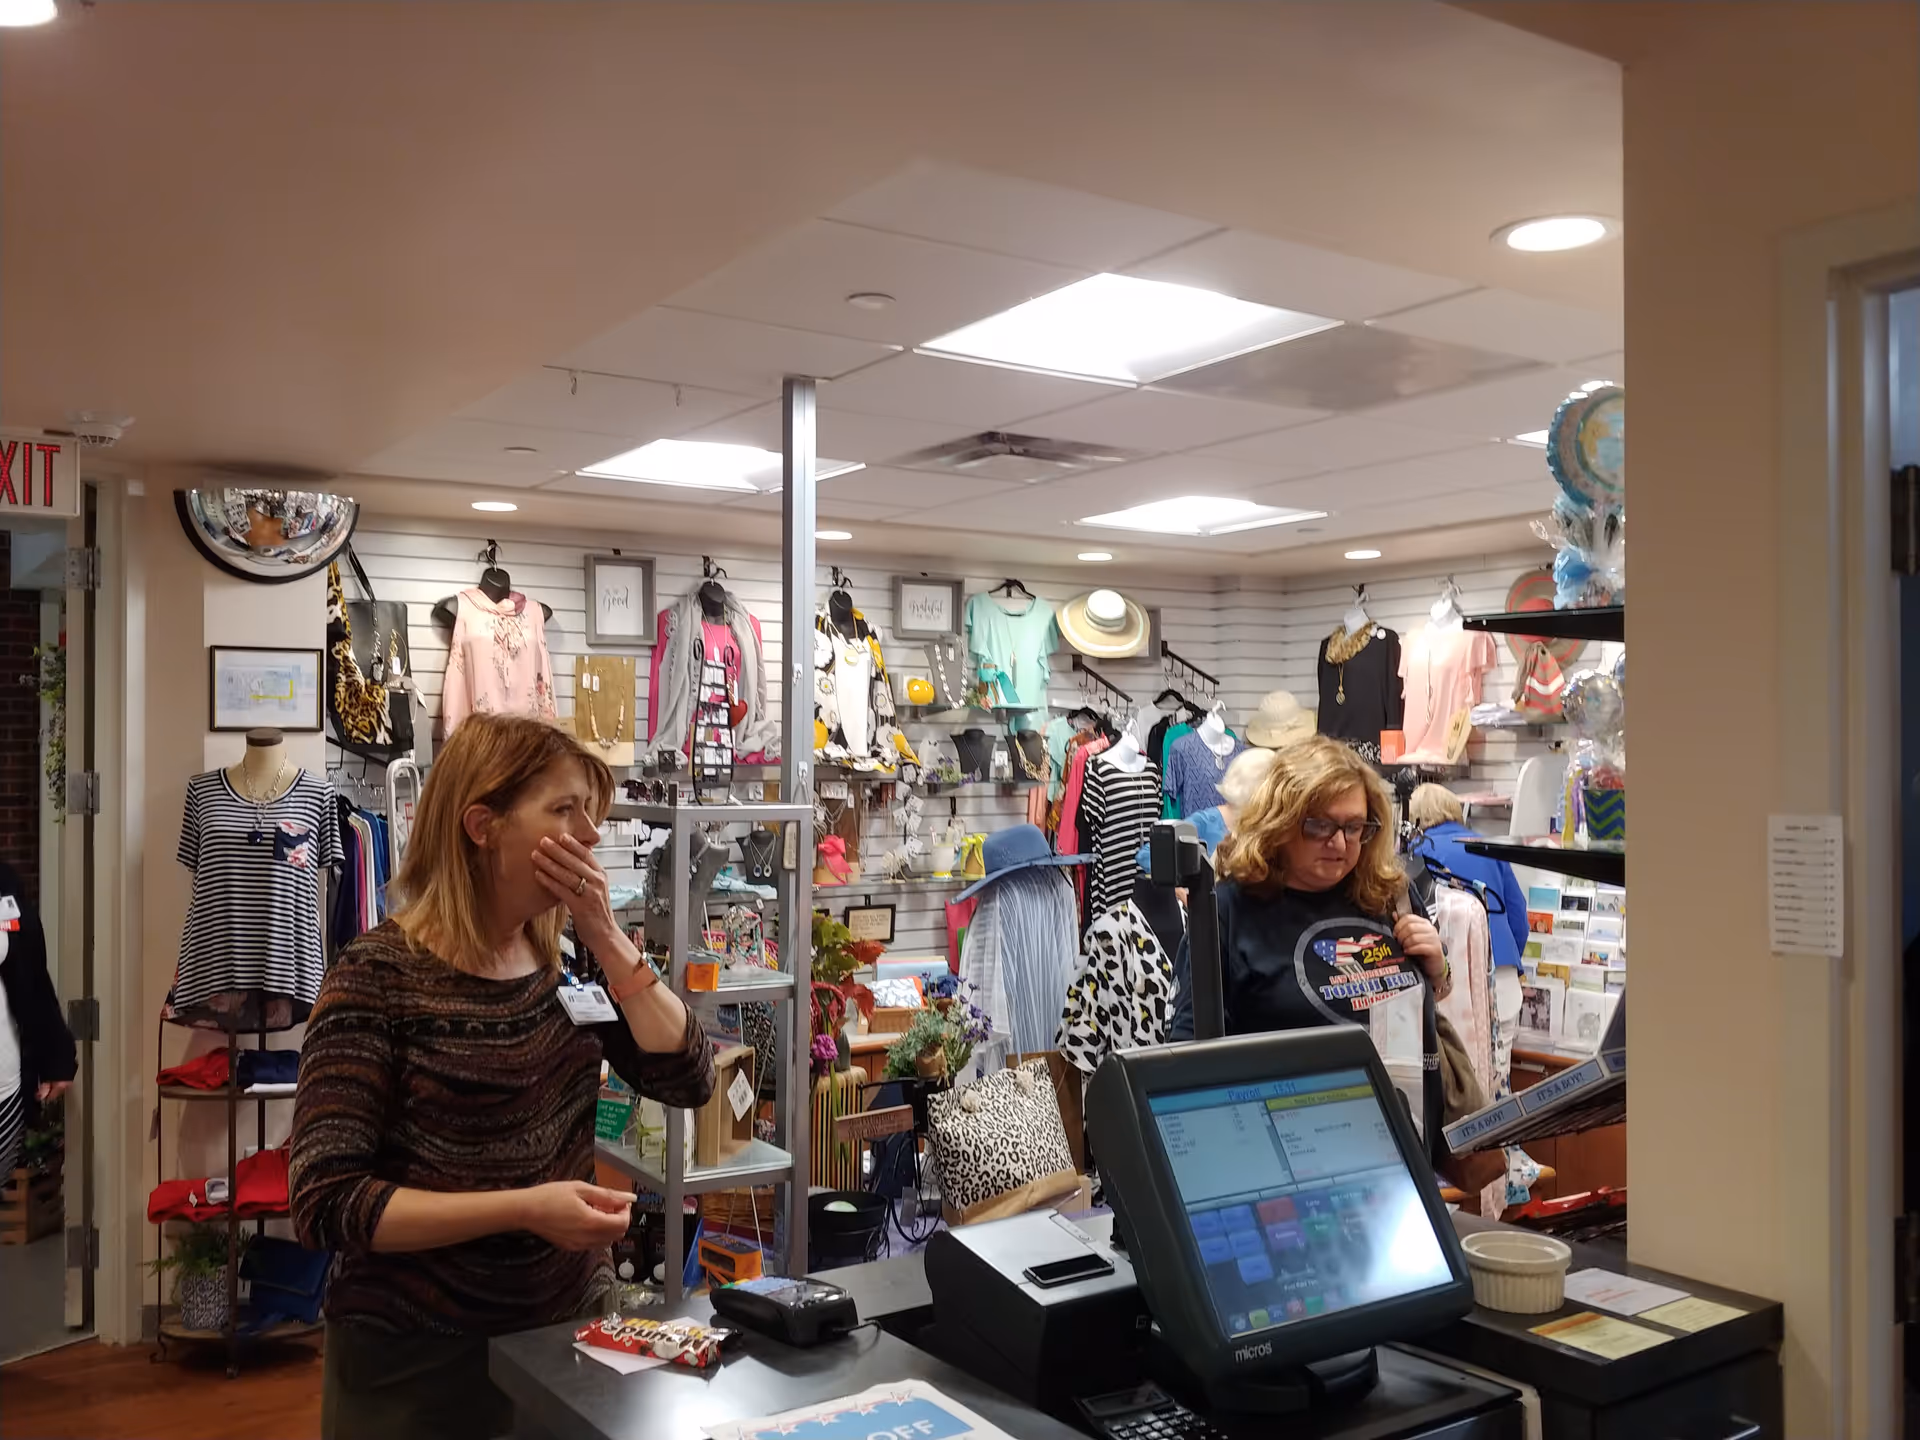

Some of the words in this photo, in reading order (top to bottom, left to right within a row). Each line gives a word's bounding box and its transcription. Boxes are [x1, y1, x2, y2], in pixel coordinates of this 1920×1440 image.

[1362, 943, 1393, 964] 25th
[1319, 977, 1384, 1001] TORCH
[1384, 970, 1418, 990] RUN
[1554, 1082, 1562, 1094] A
[1477, 1120, 1485, 1131] A
[1235, 1341, 1273, 1363] micros
[866, 1419, 934, 1440] OFF
